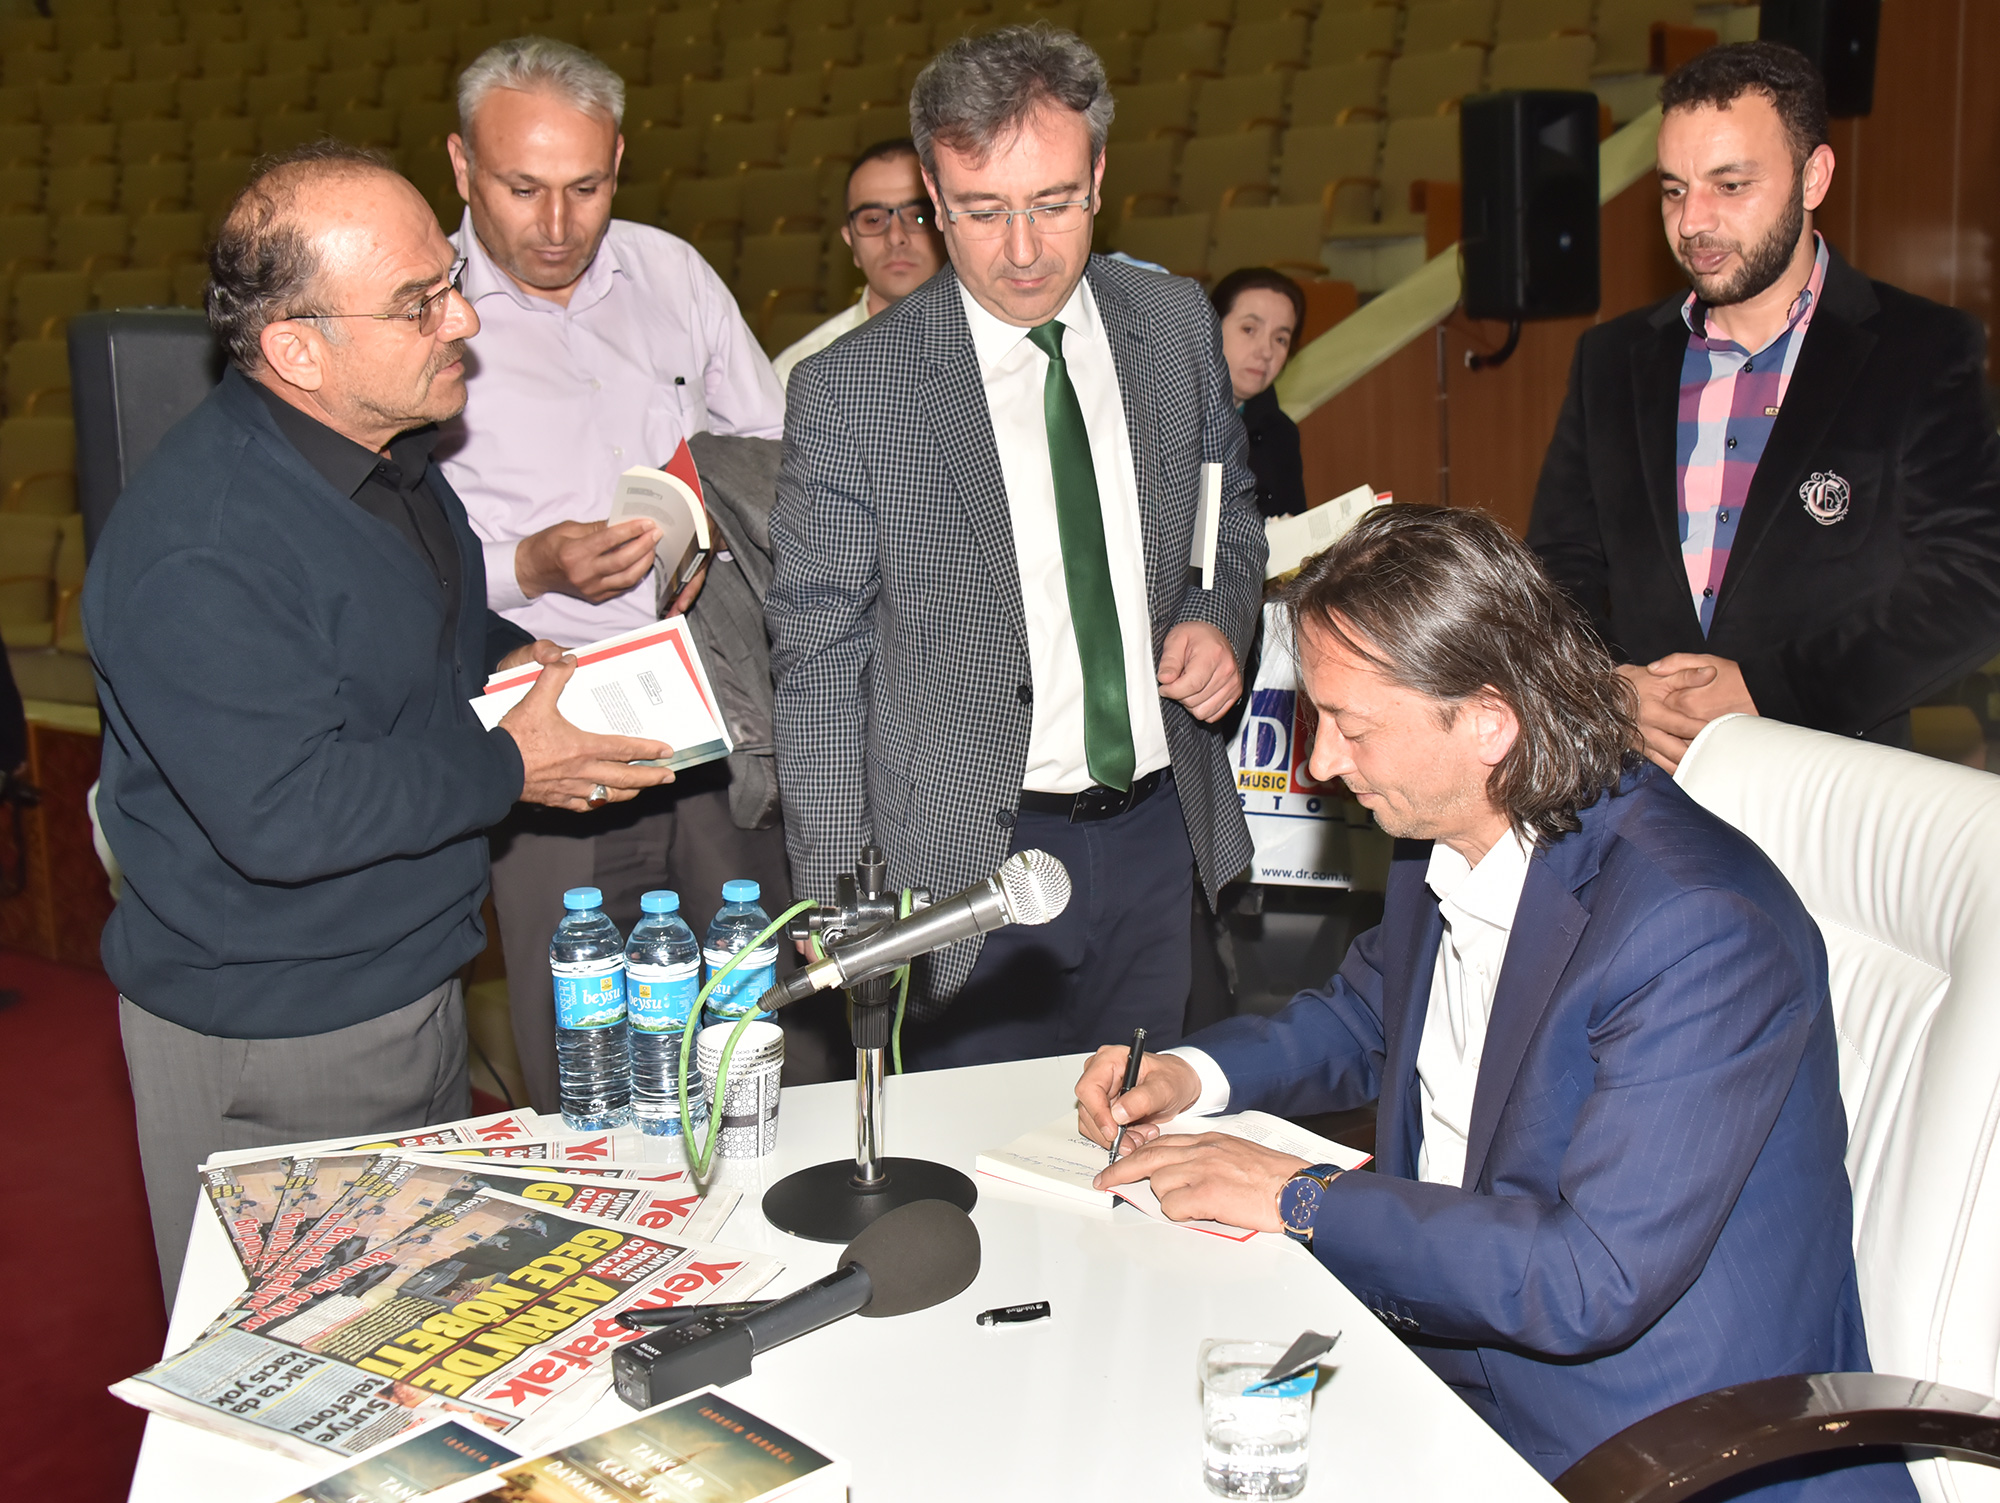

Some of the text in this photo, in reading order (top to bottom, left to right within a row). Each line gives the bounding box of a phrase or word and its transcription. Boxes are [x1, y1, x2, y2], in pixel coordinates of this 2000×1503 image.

[1239, 773, 1287, 790] MUSIC
[582, 988, 621, 1009] beysu
[628, 989, 662, 1011] beysu
[384, 1162, 418, 1183] Terör
[451, 1196, 489, 1214] Terör
[321, 1225, 360, 1245] Bin
[290, 1245, 334, 1272] polis
[352, 1250, 396, 1270] Bin
[507, 1228, 624, 1290] GECE
[587, 1238, 645, 1275] OLACAK
[607, 1244, 661, 1277] ÖRNEK
[621, 1247, 679, 1282] DÜNYAYA
[243, 1272, 302, 1311] geliyor
[305, 1266, 361, 1295] polis
[238, 1290, 313, 1332] geliyor
[356, 1282, 539, 1380] NÖBETİ
[409, 1275, 619, 1397] AFRİN'DE
[640, 1343, 661, 1355] SONY
[257, 1356, 327, 1398] Irak'ta
[210, 1380, 255, 1407] yok
[230, 1397, 261, 1414] da
[290, 1377, 387, 1434] telefonu
[315, 1398, 391, 1442] Suriye
[630, 1442, 705, 1491] TANKLAR
